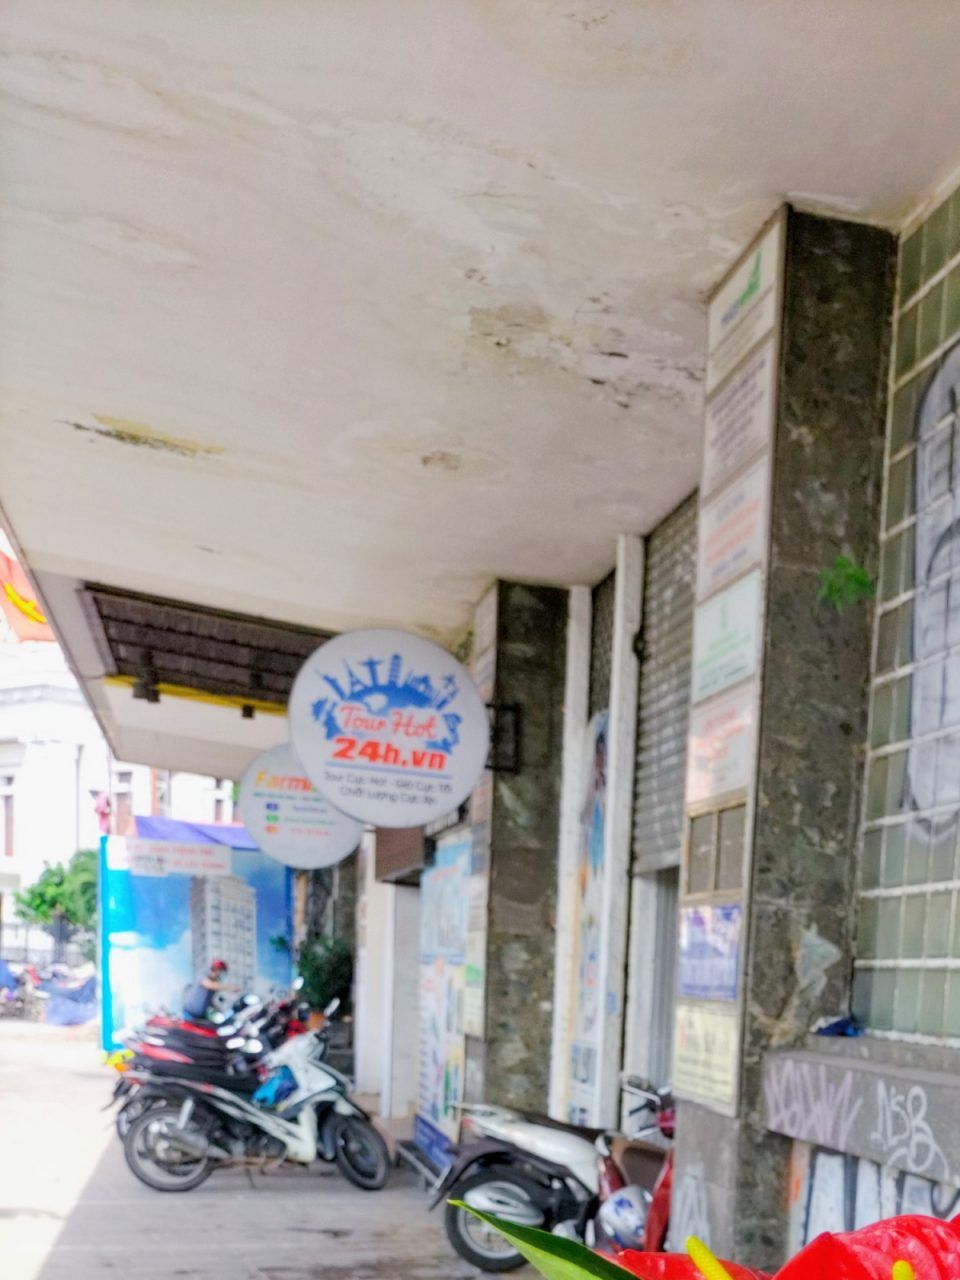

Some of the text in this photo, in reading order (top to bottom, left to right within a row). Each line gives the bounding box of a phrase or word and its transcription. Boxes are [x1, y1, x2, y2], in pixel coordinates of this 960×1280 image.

[339, 704, 437, 738] Tour Hot
[332, 737, 447, 770] 24h.vn
